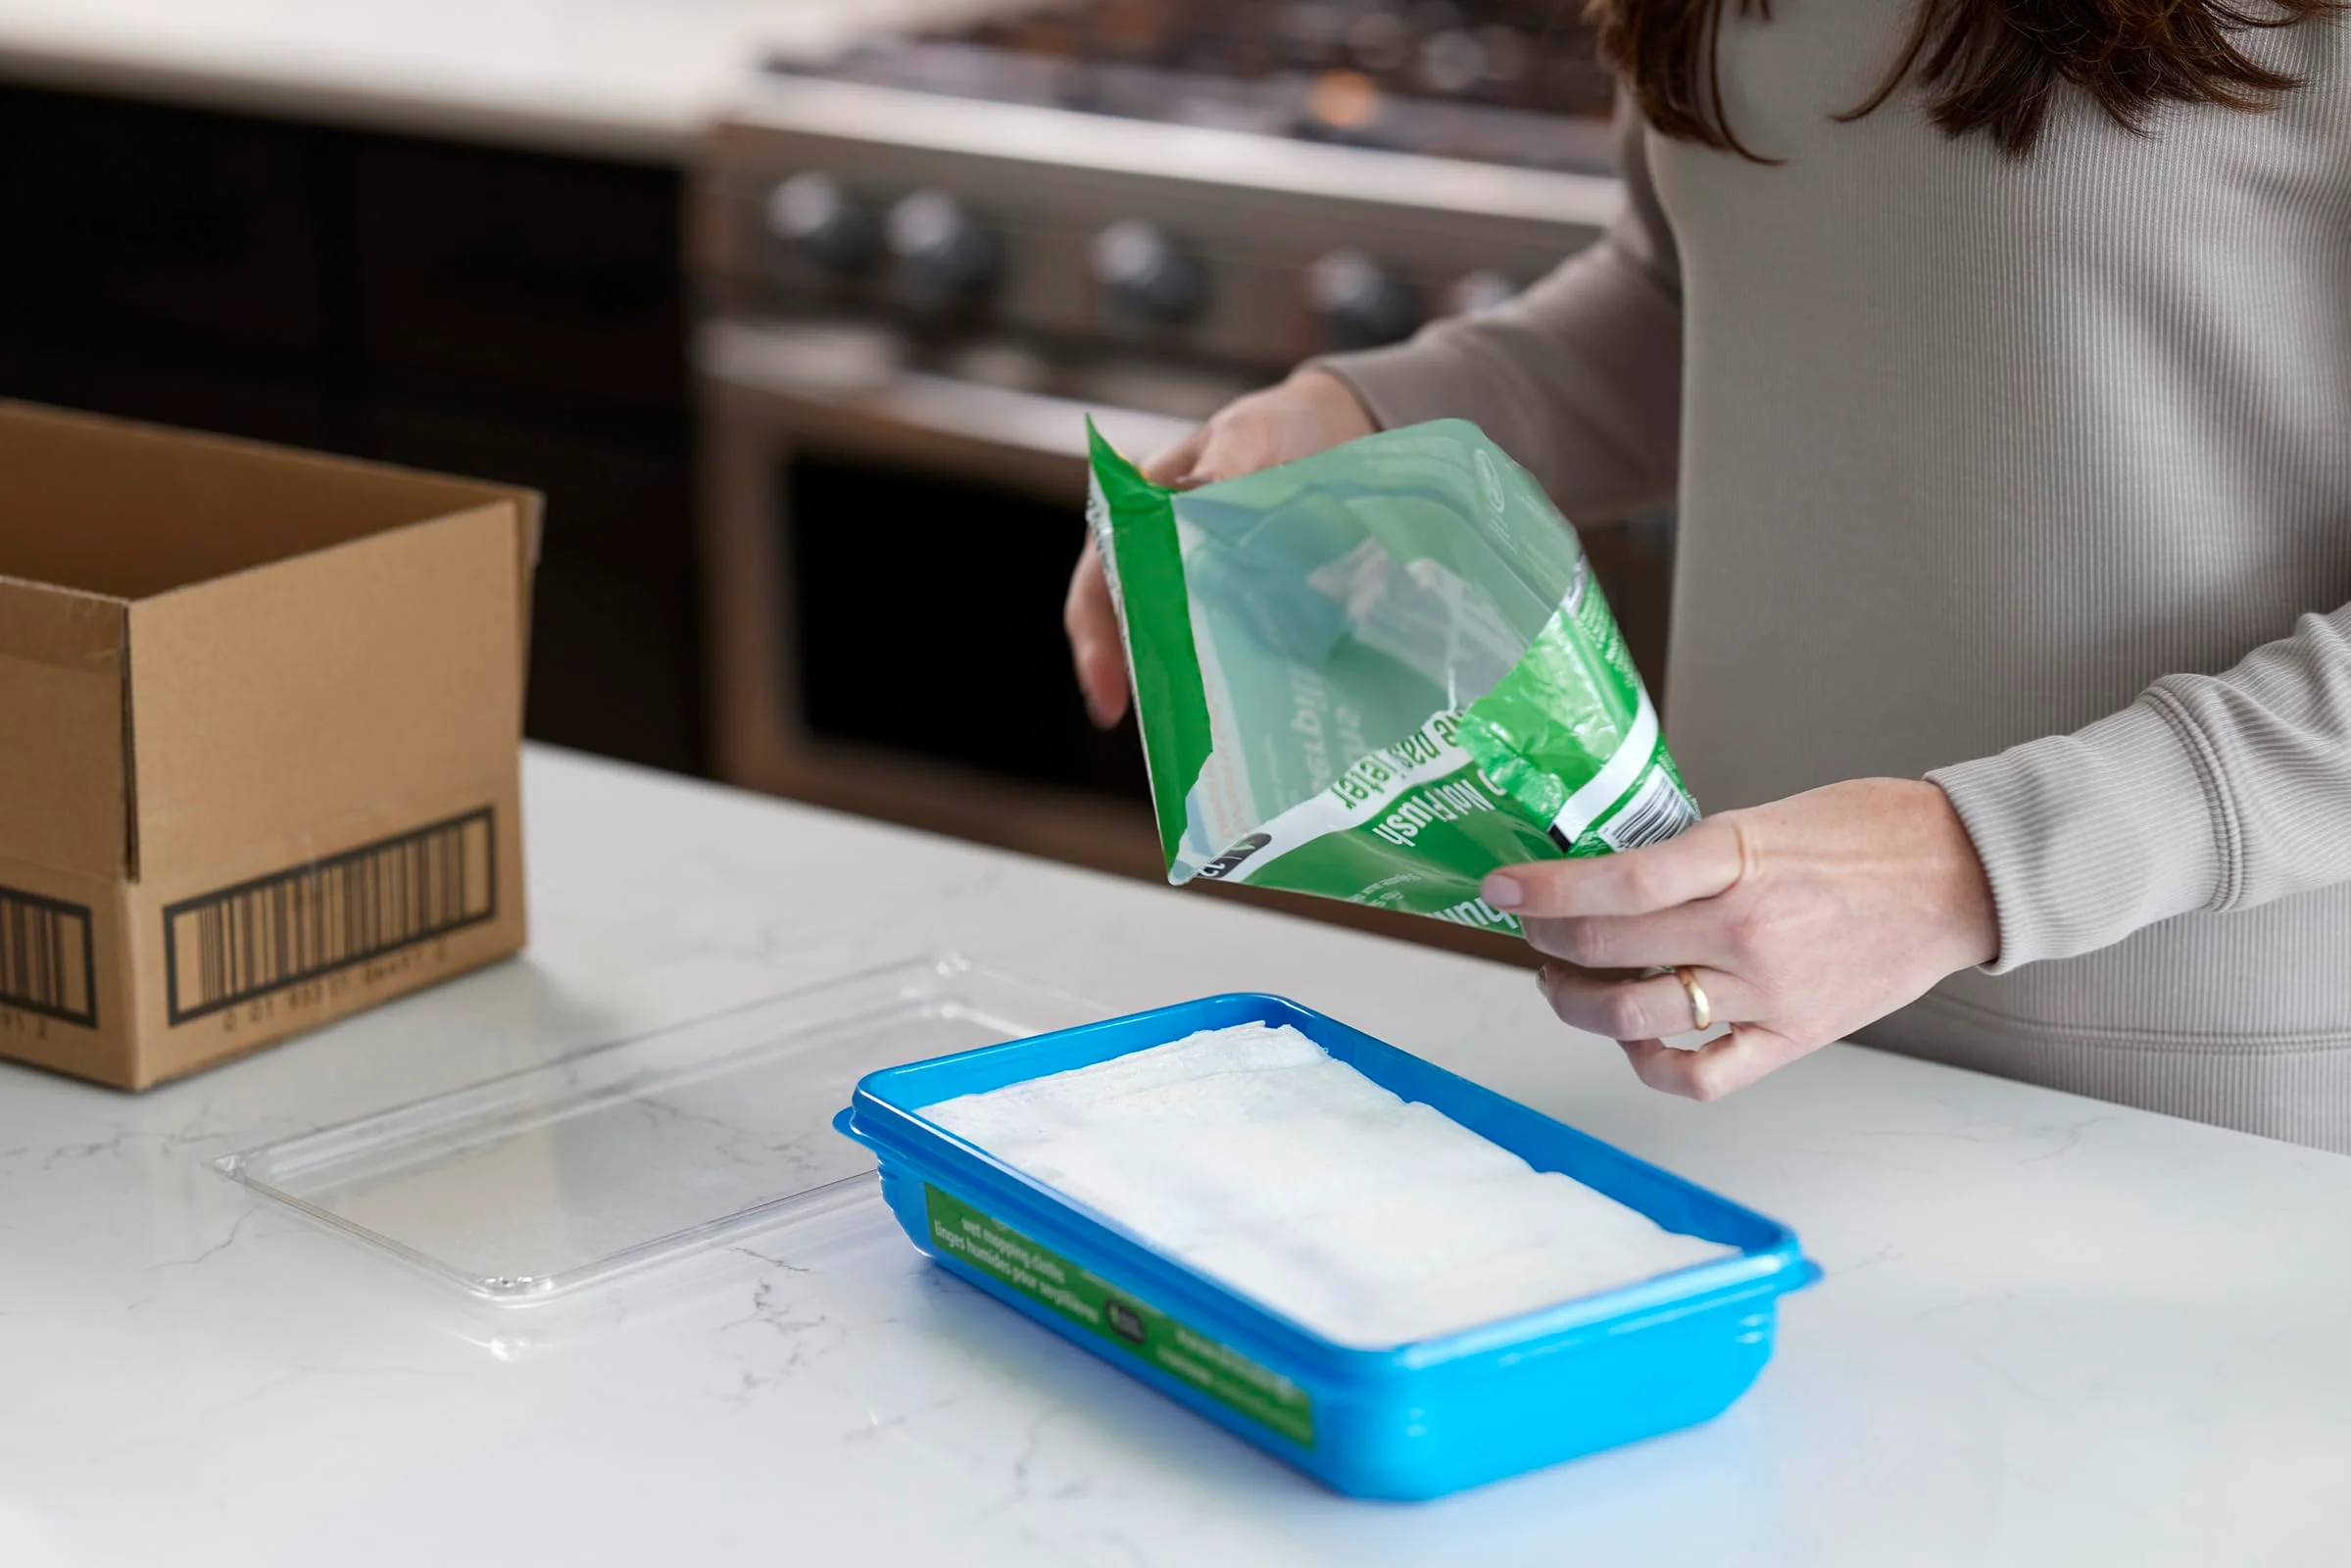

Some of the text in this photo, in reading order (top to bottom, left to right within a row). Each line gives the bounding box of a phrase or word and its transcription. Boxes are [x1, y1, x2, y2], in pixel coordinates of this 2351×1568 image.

[1389, 729, 1442, 769] pas
[1332, 752, 1407, 810] jeter
[1435, 779, 1495, 814] Not
[1372, 787, 1459, 848] Flush
